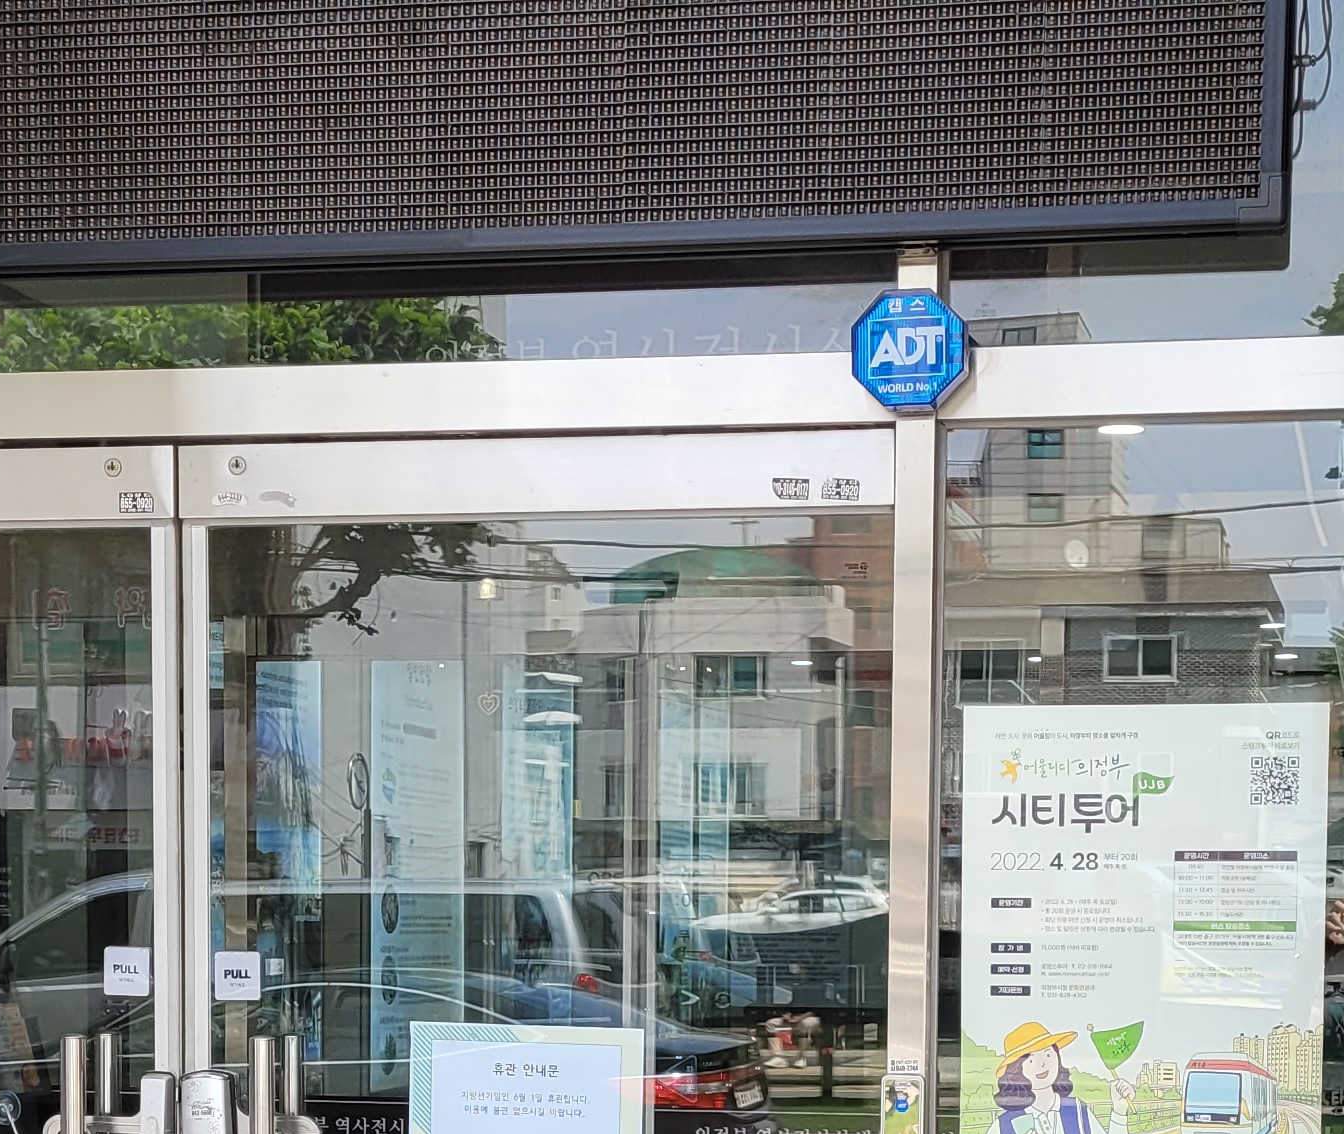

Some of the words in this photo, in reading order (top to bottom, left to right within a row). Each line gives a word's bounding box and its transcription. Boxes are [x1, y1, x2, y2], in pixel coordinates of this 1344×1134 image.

[870, 326, 945, 368] ADT
[878, 383, 913, 393] WORLD
[1139, 778, 1166, 790] UJB
[991, 793, 1139, 833] 시티투어
[990, 852, 1045, 871] 2022.
[1071, 852, 1099, 870] 28
[113, 964, 140, 975] PULL
[224, 969, 251, 979] PULL
[492, 1062, 517, 1077] 휴관
[523, 1063, 560, 1078] 안내문
